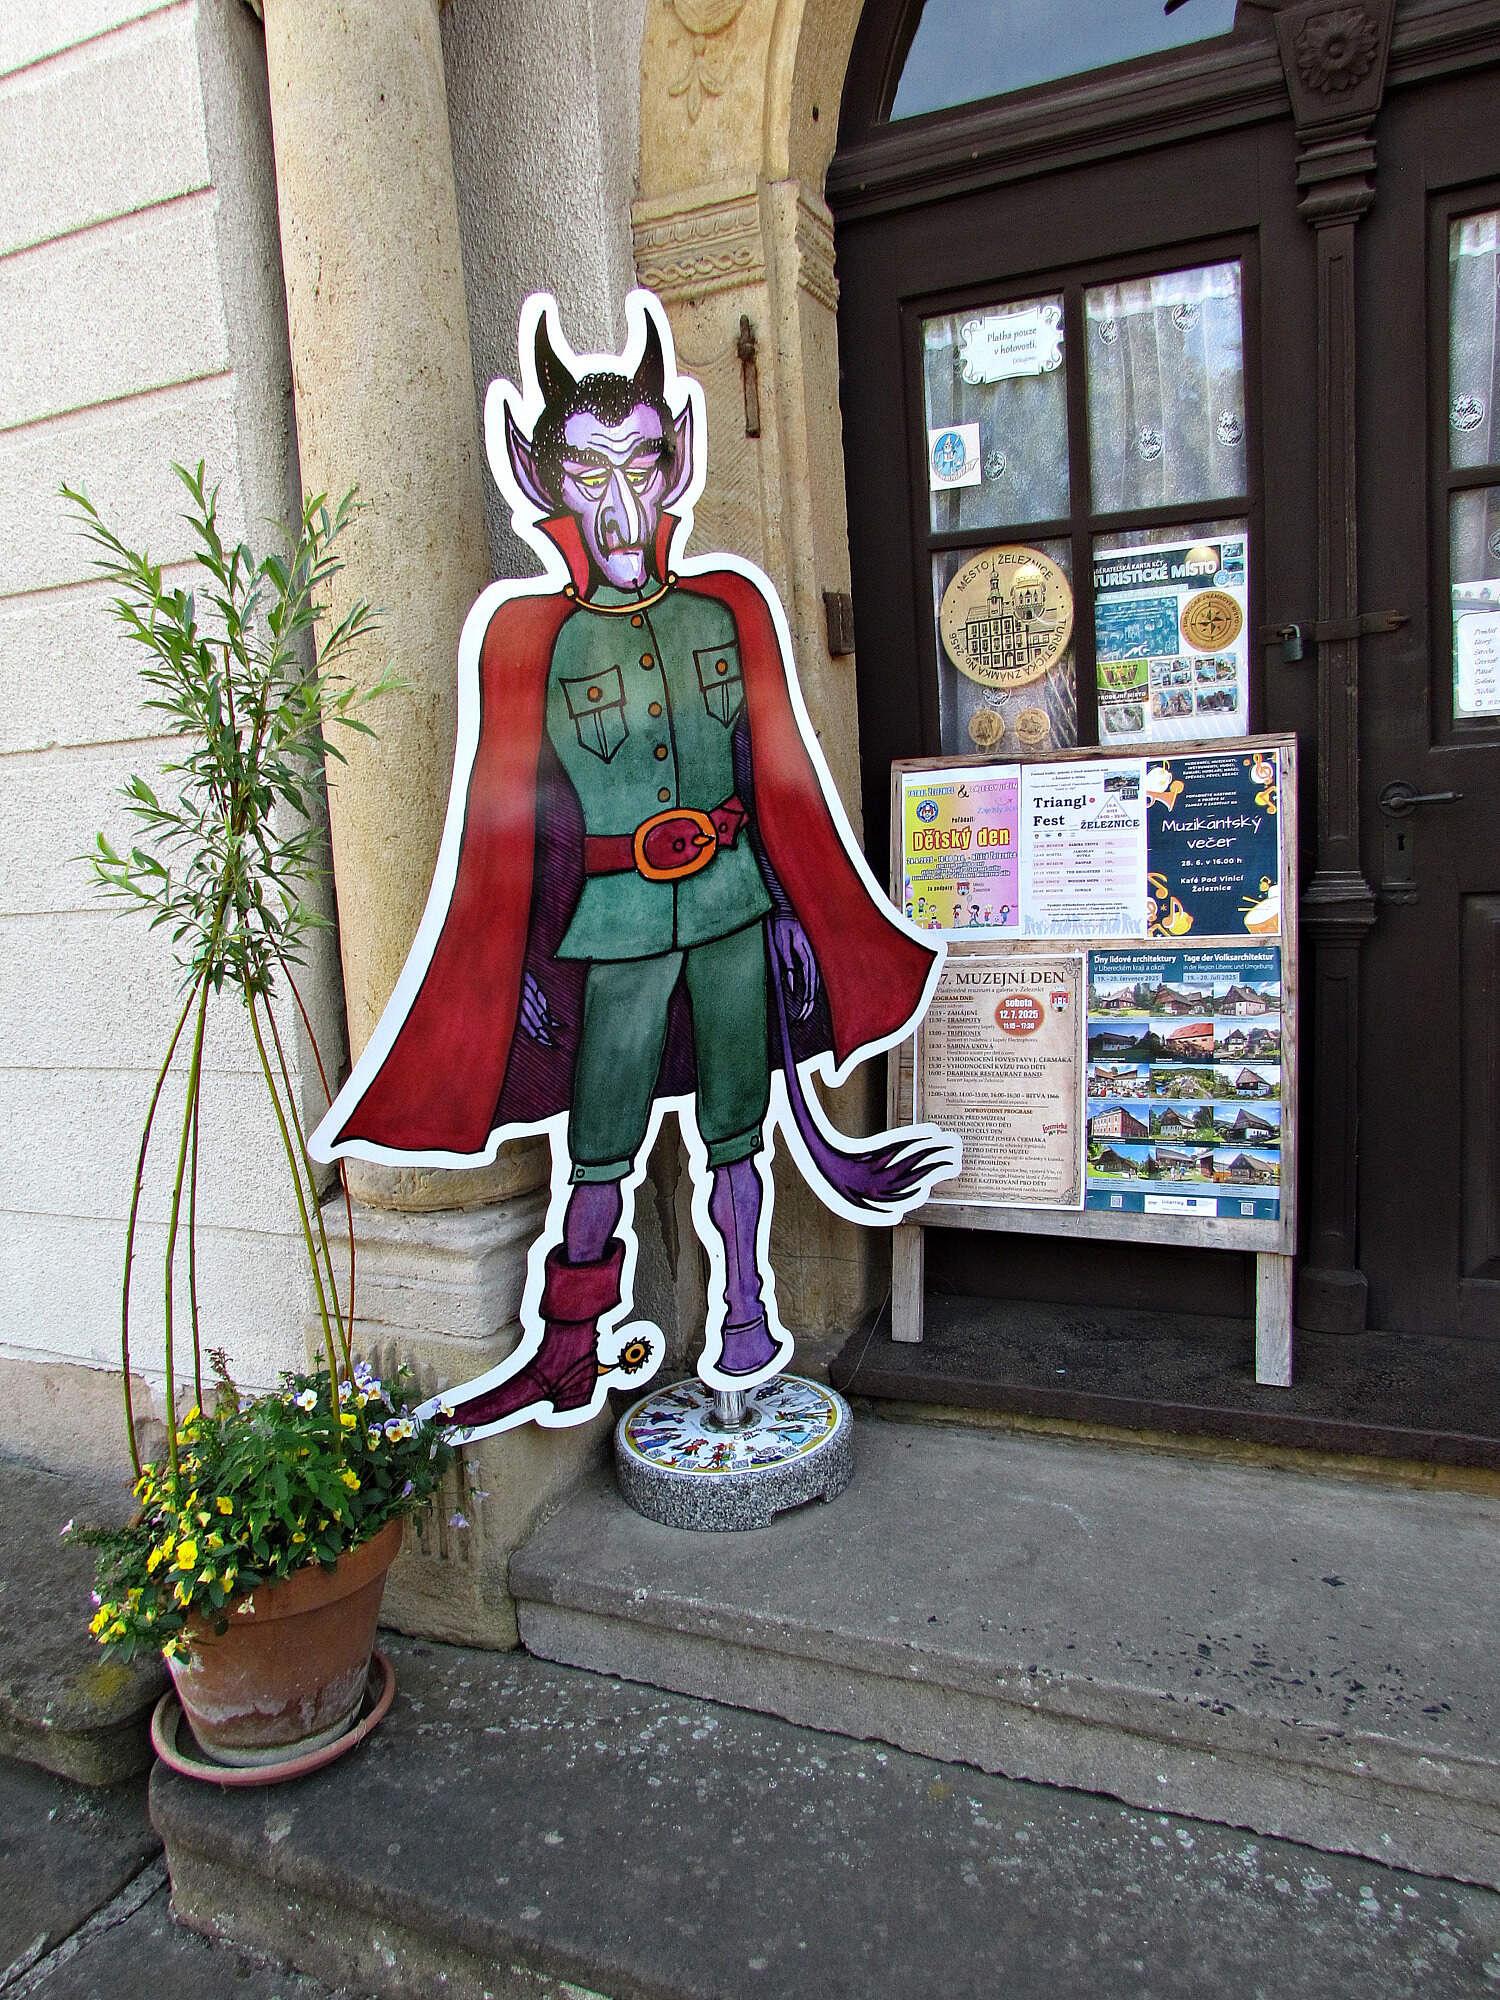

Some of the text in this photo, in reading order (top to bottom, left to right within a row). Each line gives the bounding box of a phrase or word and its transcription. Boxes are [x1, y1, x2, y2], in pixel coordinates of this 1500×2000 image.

[957, 554, 1053, 592] MĚSTO ŽELEZNICE
[1093, 560, 1217, 588] TURISTICKÉ MÍSTO
[949, 632, 964, 656] 2456
[1024, 619, 1067, 675] TURISTICKÁ
[978, 666, 1021, 681] ZNÁMKA
[957, 784, 970, 798] &
[1033, 795, 1087, 809] Triangl
[1033, 815, 1065, 827] Fest
[1080, 819, 1140, 830] ŽELEZNICE
[912, 826, 1011, 850] Dětský den
[1187, 837, 1237, 849] večer
[1180, 876, 1198, 884] Kafé
[1094, 955, 1177, 964] Dny lidové architektury
[1183, 953, 1274, 963] Tage der Volksarchitektur
[1245, 963, 1274, 971] Umgebung
[956, 969, 1025, 986] MUZEJNÍ
[1031, 972, 1065, 984] DEN
[1005, 999, 1033, 1007] sobota
[1000, 1010, 1039, 1019] 12. 7. 2025
